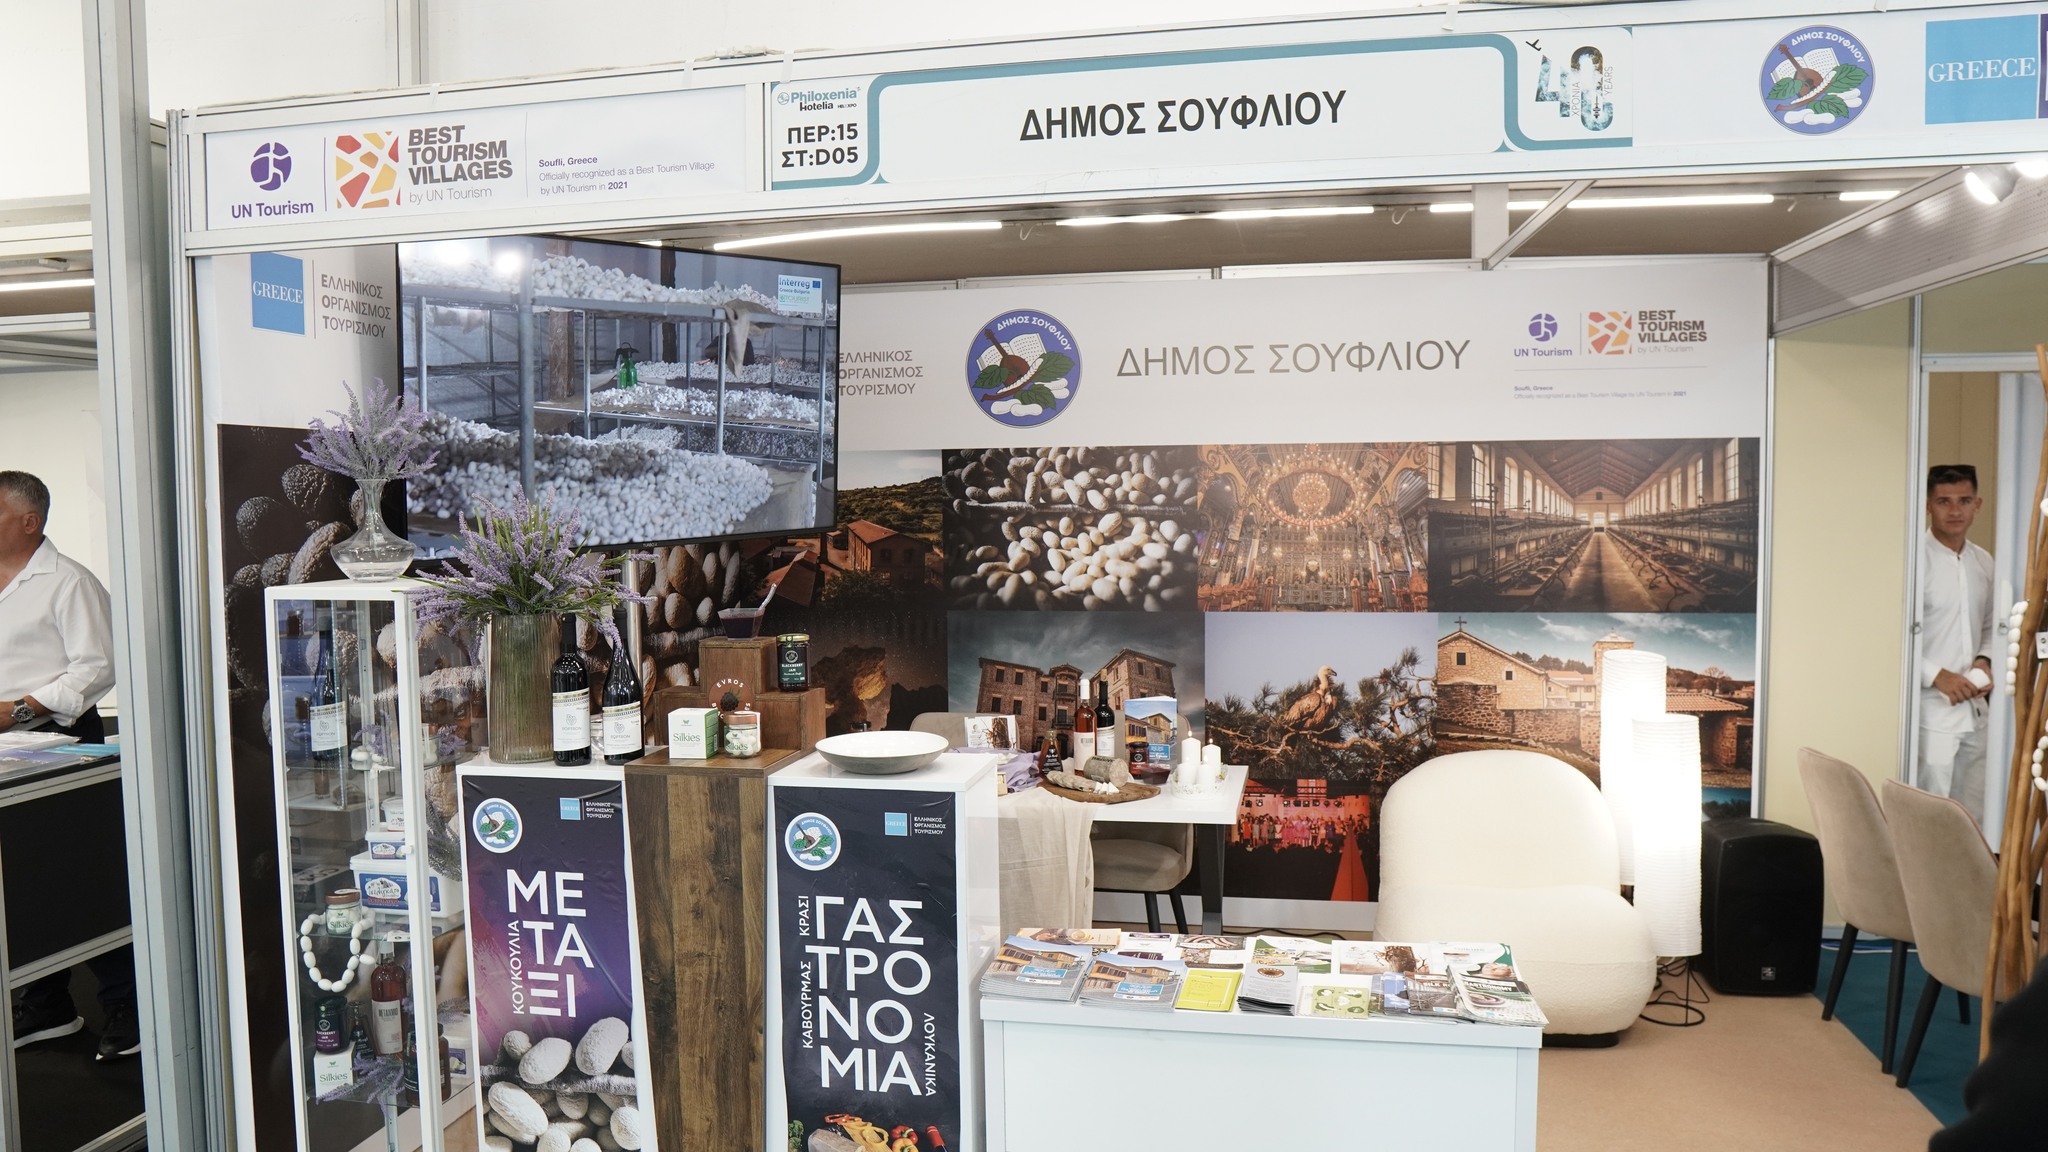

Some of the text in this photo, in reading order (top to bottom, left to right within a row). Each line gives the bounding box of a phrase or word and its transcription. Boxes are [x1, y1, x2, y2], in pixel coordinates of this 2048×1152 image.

[1791, 31, 1866, 64] ΔΗΜΟΣ ΣΟΥΦΛΙΟΥ
[1604, 66, 1613, 97] YEARS
[1928, 57, 2036, 83] GREECE
[791, 88, 857, 104] Philoxenia
[799, 101, 834, 111] Hotelia
[1571, 81, 1580, 117] ΧΡΟΝΙΑ
[1019, 90, 1347, 141] ΔΗΜΟΣ ΣΟΥΦΛΙΟΥ
[408, 125, 466, 147] BEST
[788, 123, 858, 144] ΠΕΡ:15
[408, 140, 508, 166] TOURISM
[538, 155, 598, 168] Soufli, Greece
[782, 146, 858, 168] ΣΤ:D05
[408, 159, 513, 186] VILLAGES
[539, 161, 715, 182] Officially recognized as a Best Tourism Village
[409, 186, 492, 206] by UN Tourism
[540, 181, 628, 195] by UN Tourism in 2021
[232, 200, 314, 219] UN Tourism
[252, 280, 304, 305] GREECE
[321, 273, 384, 300] ΕΛΛΗΝΙΚΟΣ
[321, 294, 392, 320] ΟΡΓΑΝΙΣΜΟΣ
[1638, 310, 1676, 321] BEST
[322, 315, 386, 339] ΤΟΥΡΙΣΜΟΥ
[997, 316, 1072, 351] ΔΗΜΟΣ ΣΟΥΦΛΙΟΥ
[1638, 320, 1705, 332] TOURISM
[1638, 331, 1707, 343] VILLAGES
[839, 350, 912, 364] ΕΛΛΗΝΙΚΟΣ
[1116, 340, 1471, 378] ΔΗΜΟΣ ΣΟΥΦΛΙΟΥ
[1514, 348, 1573, 357] UN Tourism
[1637, 346, 1647, 354] by
[1662, 345, 1694, 353] Tourism
[839, 366, 924, 379] ΟΡΓΑΝΙΣΜΟΣ
[839, 383, 916, 396] ΤΟΥΡΙΣΜΟΥ
[716, 678, 744, 689] EVROS
[673, 733, 701, 742] Silkies
[506, 869, 587, 917] ΜΕ
[798, 895, 810, 936] ΚΡΑΣΙ
[815, 895, 924, 946] ΓΑΣ
[522, 920, 595, 968] ΤΑ
[507, 920, 525, 1015] ΚΟΥΚΟΥΛΙΑ
[805, 945, 932, 996] ΤΡΟ
[800, 961, 813, 1049] ΚΑΒΟΥΡΜΑΣ
[818, 995, 913, 1044] ΝΟ
[924, 1012, 937, 1097] ΛΟΥΚΑΝΙΚΑ
[319, 1072, 348, 1083] Silkies
[820, 1045, 923, 1096] ΜΙΑ
